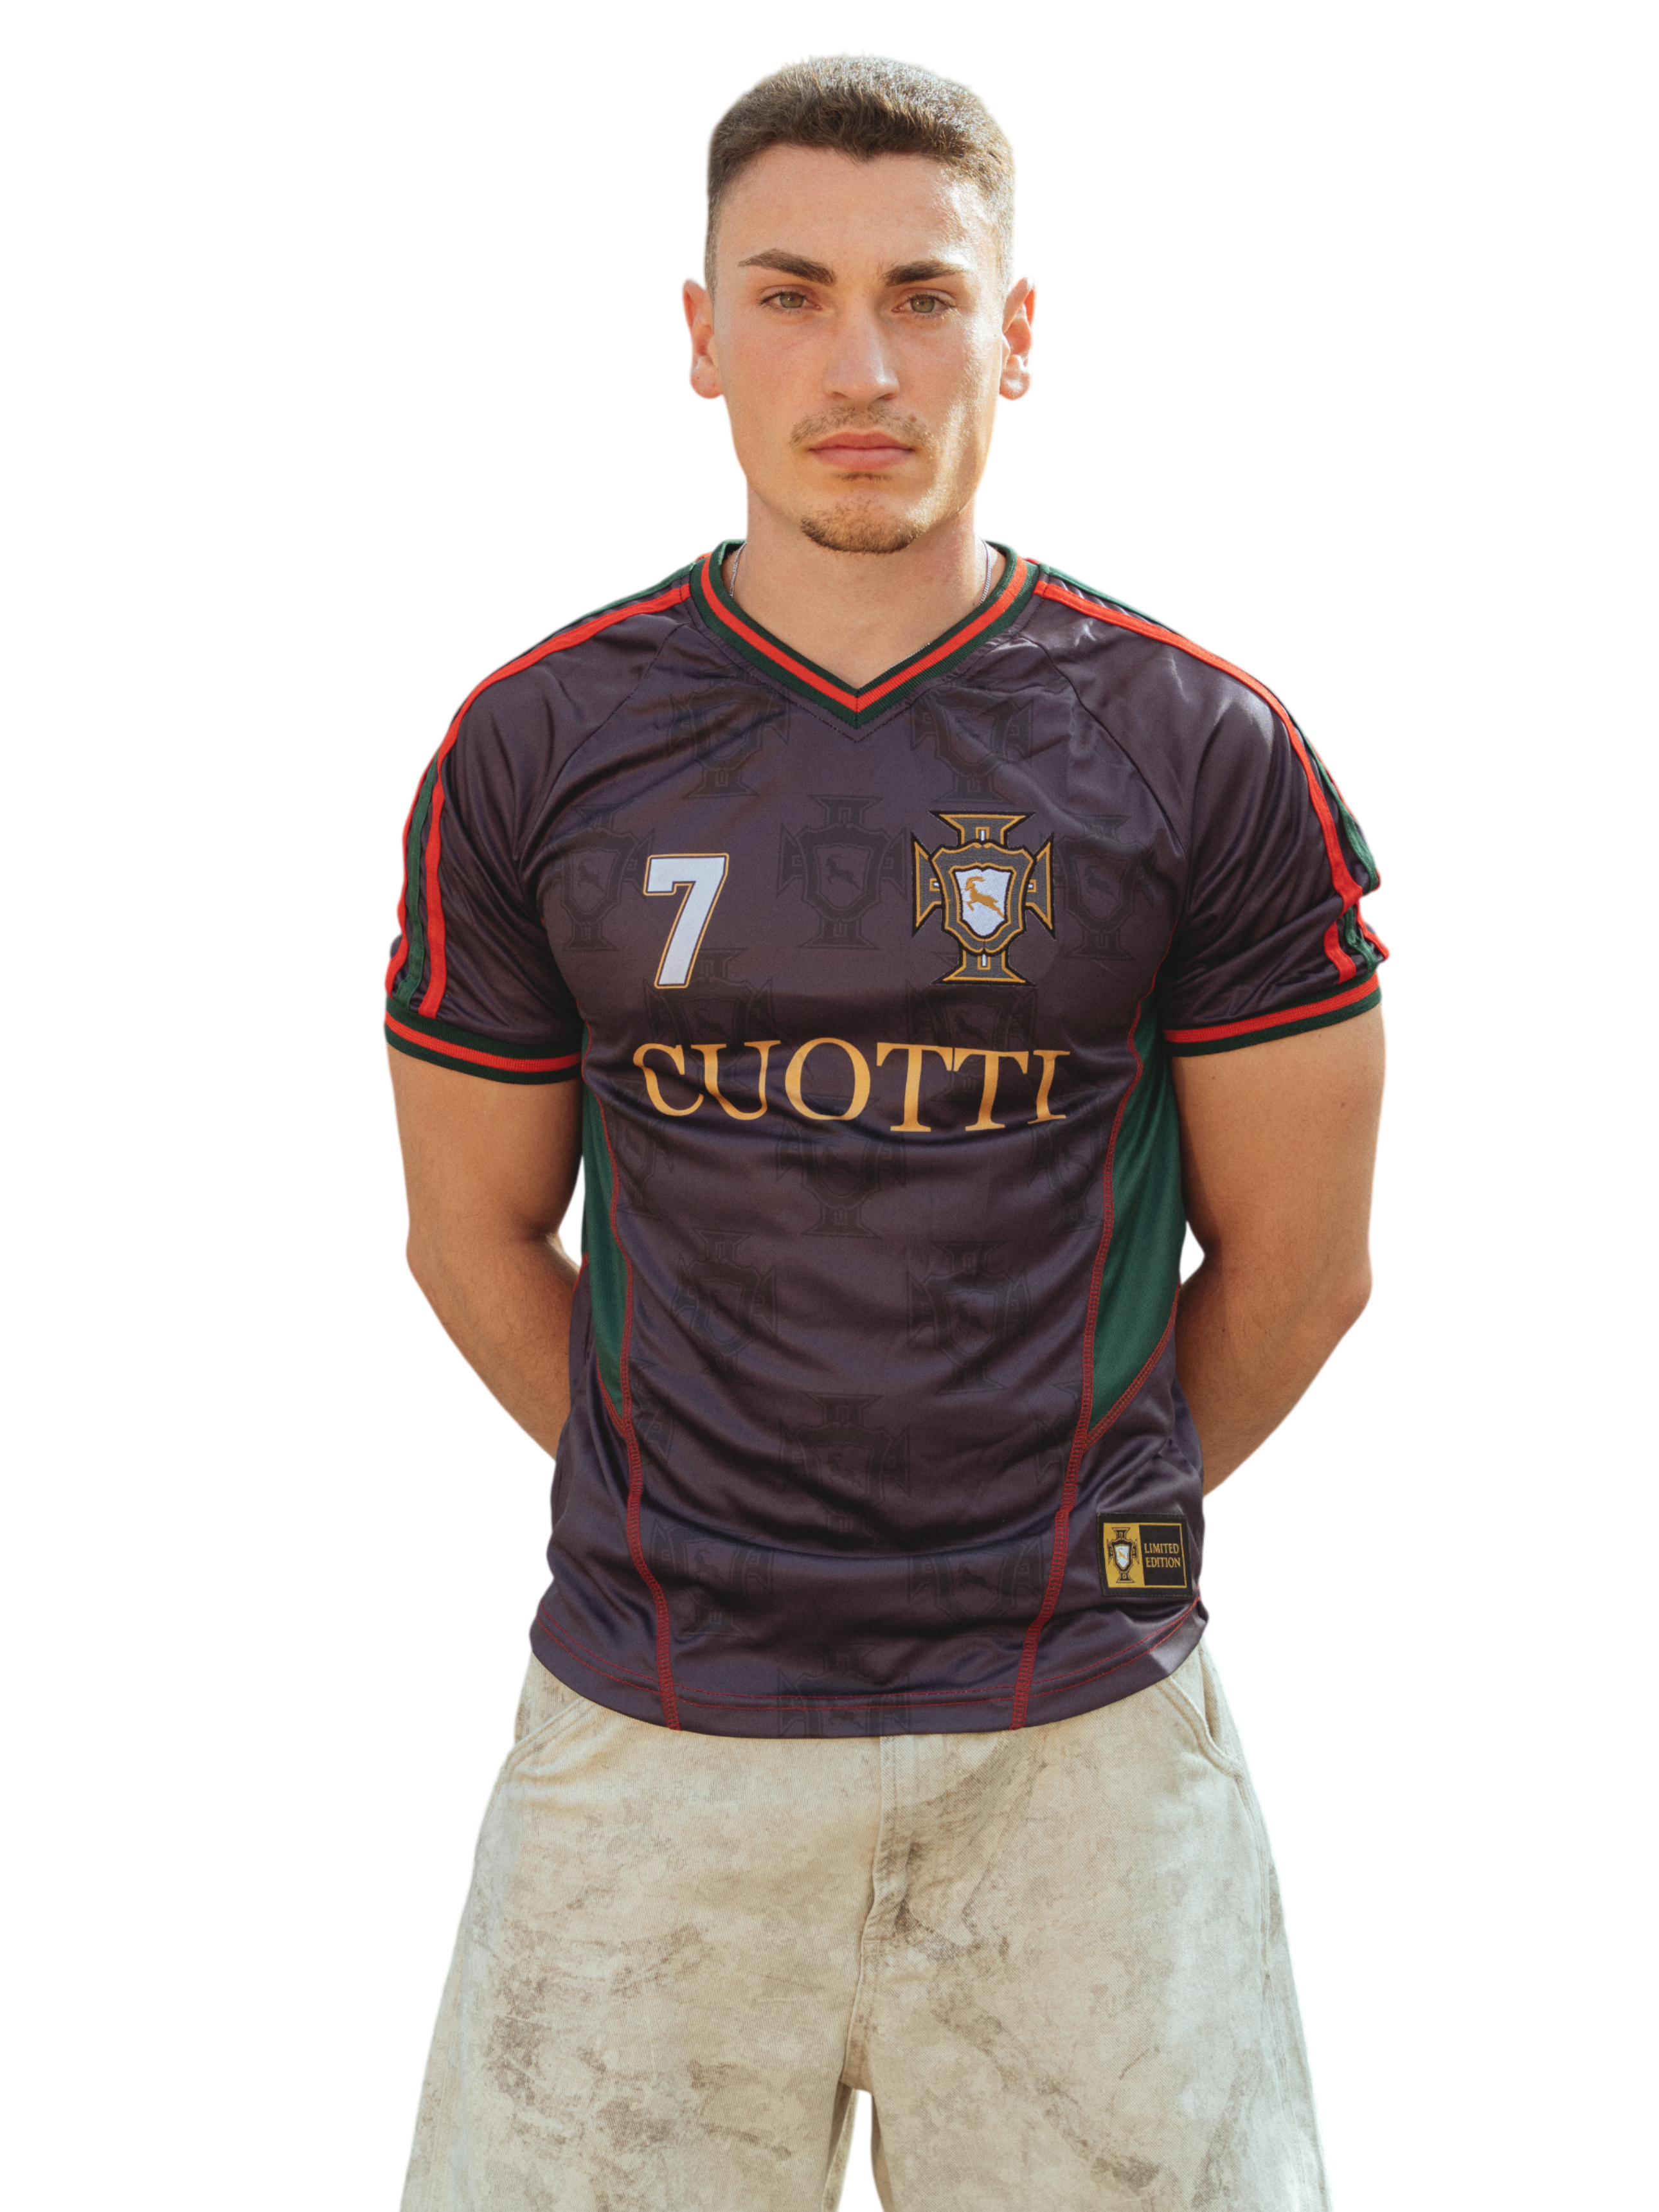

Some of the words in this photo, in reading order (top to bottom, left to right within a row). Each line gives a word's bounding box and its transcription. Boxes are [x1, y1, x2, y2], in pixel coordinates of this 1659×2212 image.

[643, 853, 729, 988] 7
[632, 1037, 1070, 1131] CUOTTI
[1144, 1543, 1179, 1554] LIMITED
[1145, 1557, 1181, 1568] EDITION
